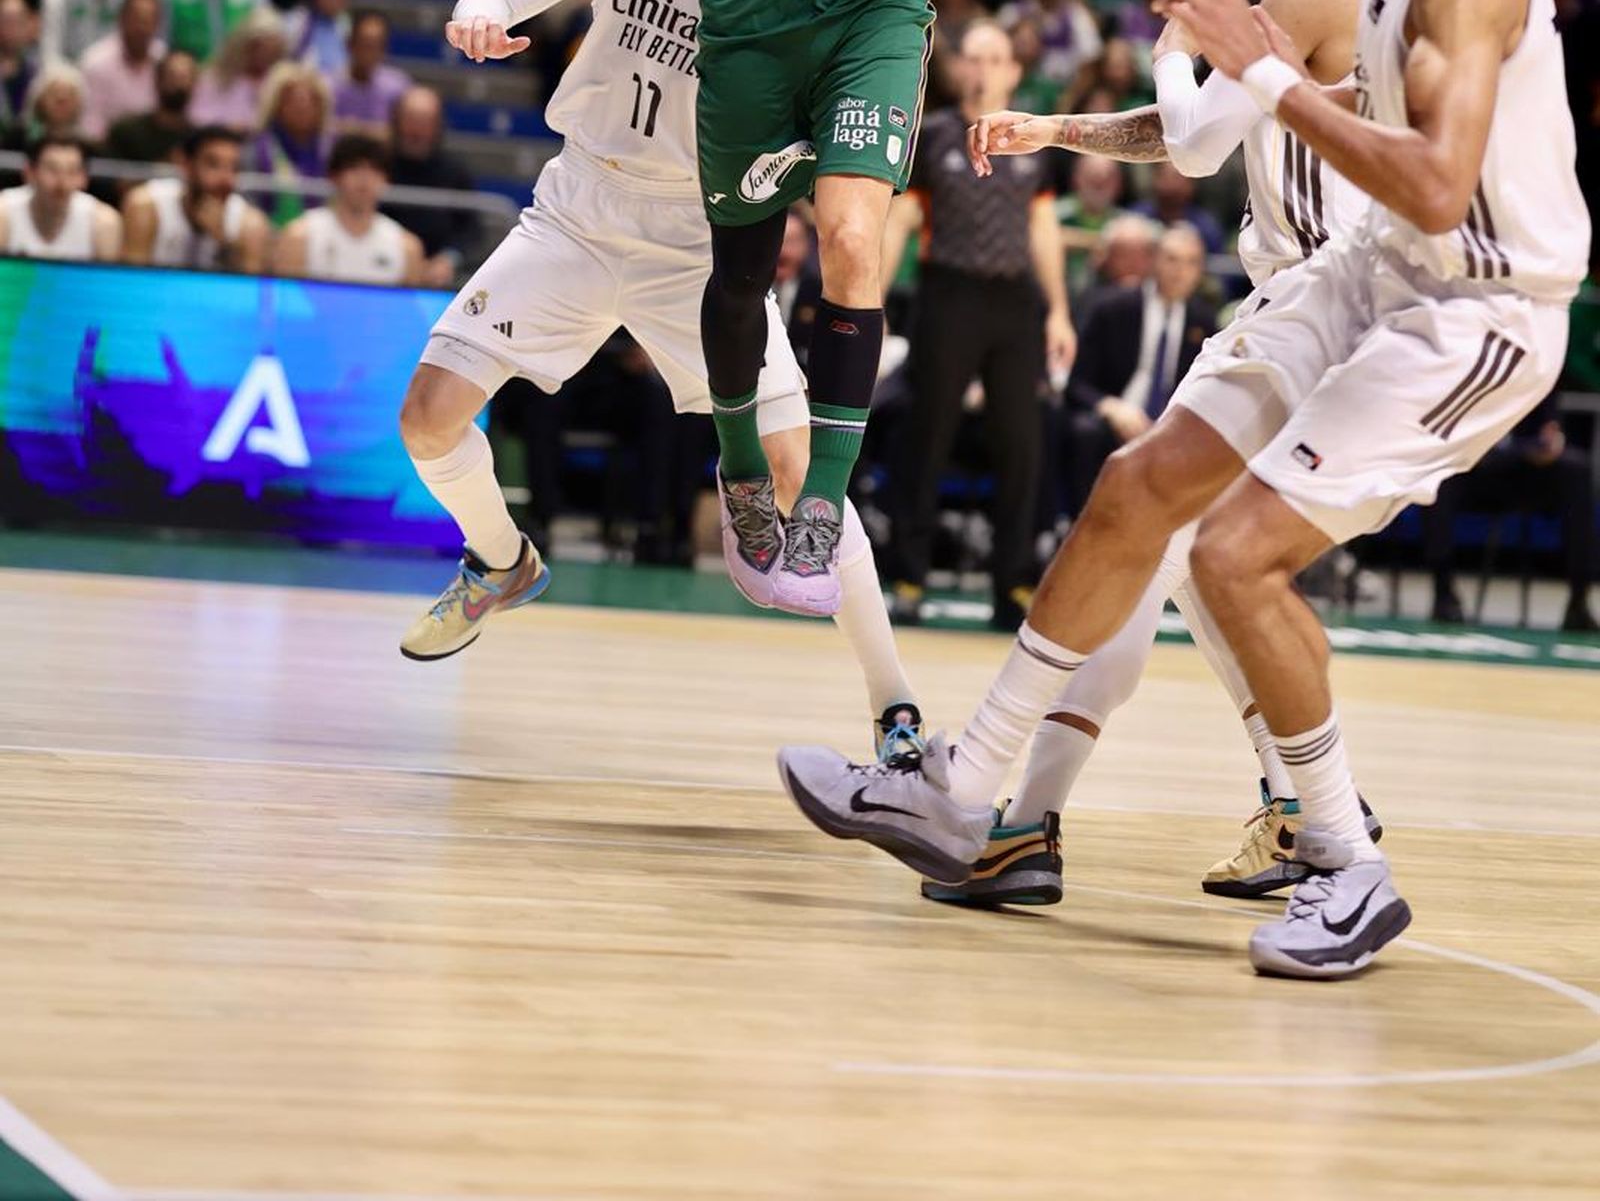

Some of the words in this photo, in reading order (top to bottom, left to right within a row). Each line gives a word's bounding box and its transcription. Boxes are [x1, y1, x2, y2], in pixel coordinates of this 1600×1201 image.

[618, 23, 648, 52] FLY
[646, 34, 701, 79] BETT
[841, 104, 881, 127] má
[832, 123, 879, 150] laga
